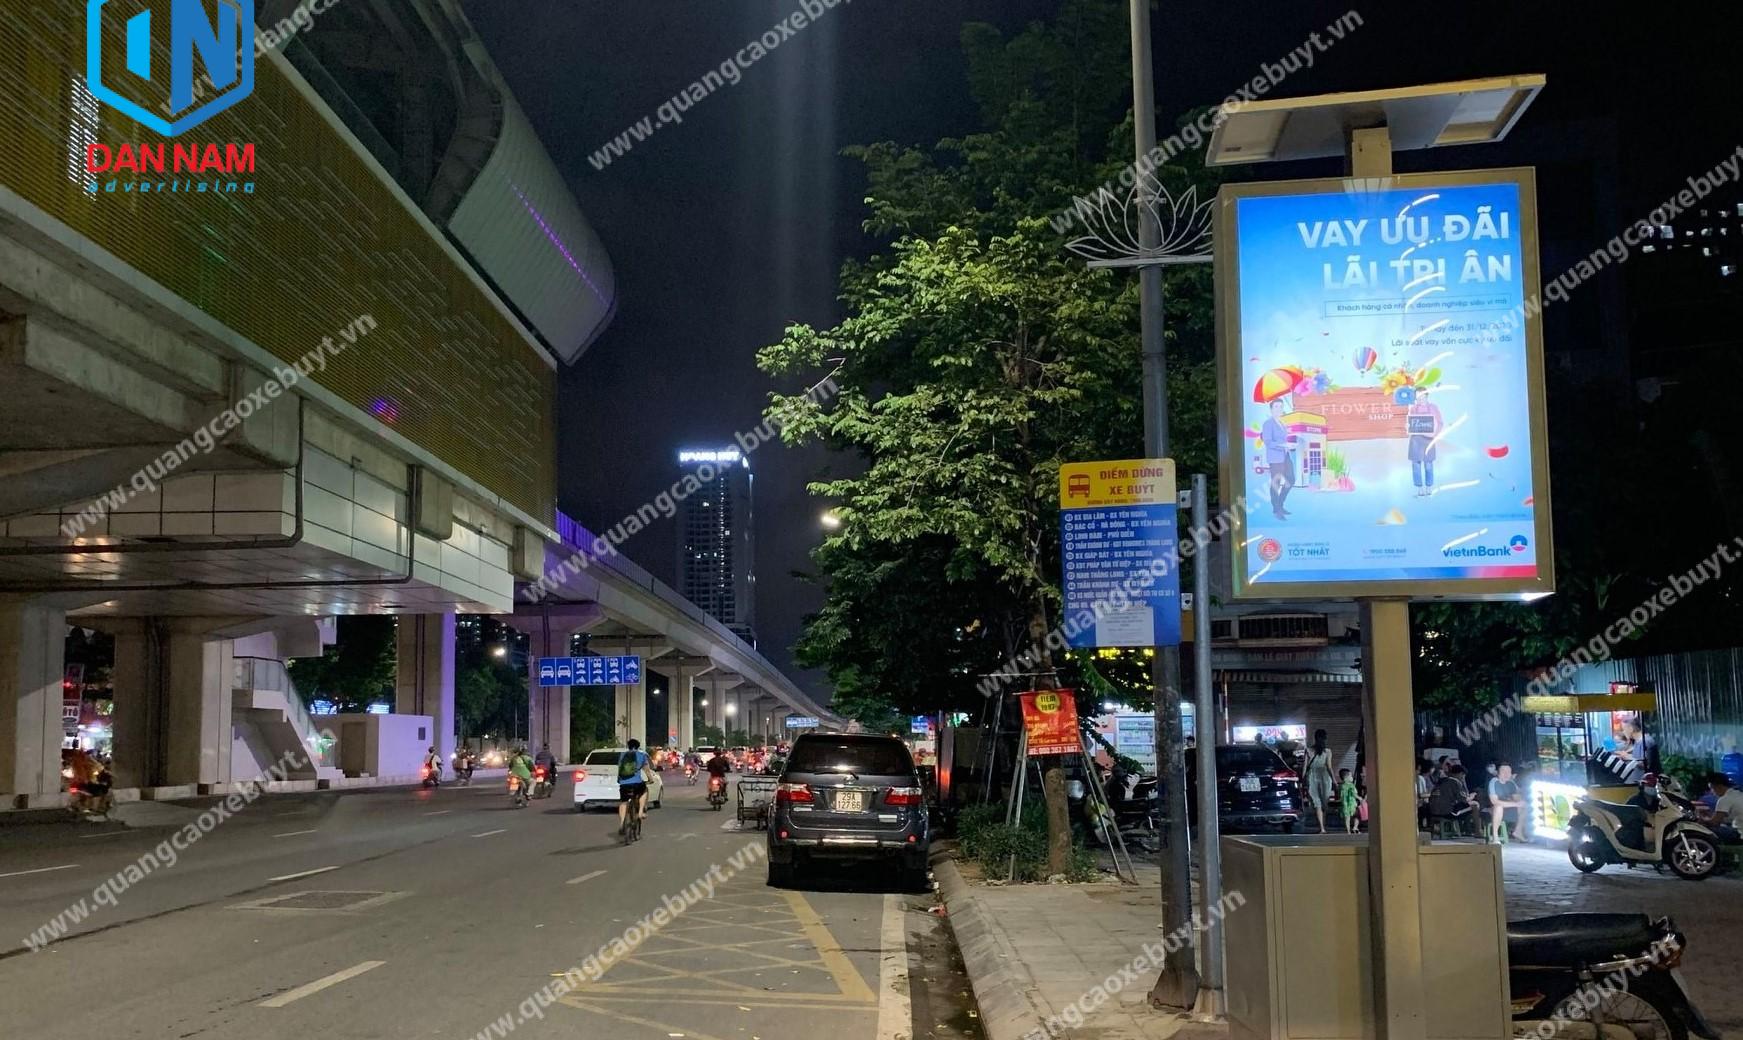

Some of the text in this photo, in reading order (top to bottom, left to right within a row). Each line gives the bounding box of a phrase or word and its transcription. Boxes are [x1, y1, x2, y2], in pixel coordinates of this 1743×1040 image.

[1297, 205, 1510, 249] VAY ƯU ĐÃI
[1322, 254, 1378, 290] LÃI
[1458, 249, 1513, 284] ÂN
[1319, 402, 1393, 416] FLOWER
[1368, 413, 1394, 421] SHOP
[1109, 485, 1124, 495] XE
[1288, 546, 1330, 557] TỐT NHẤT
